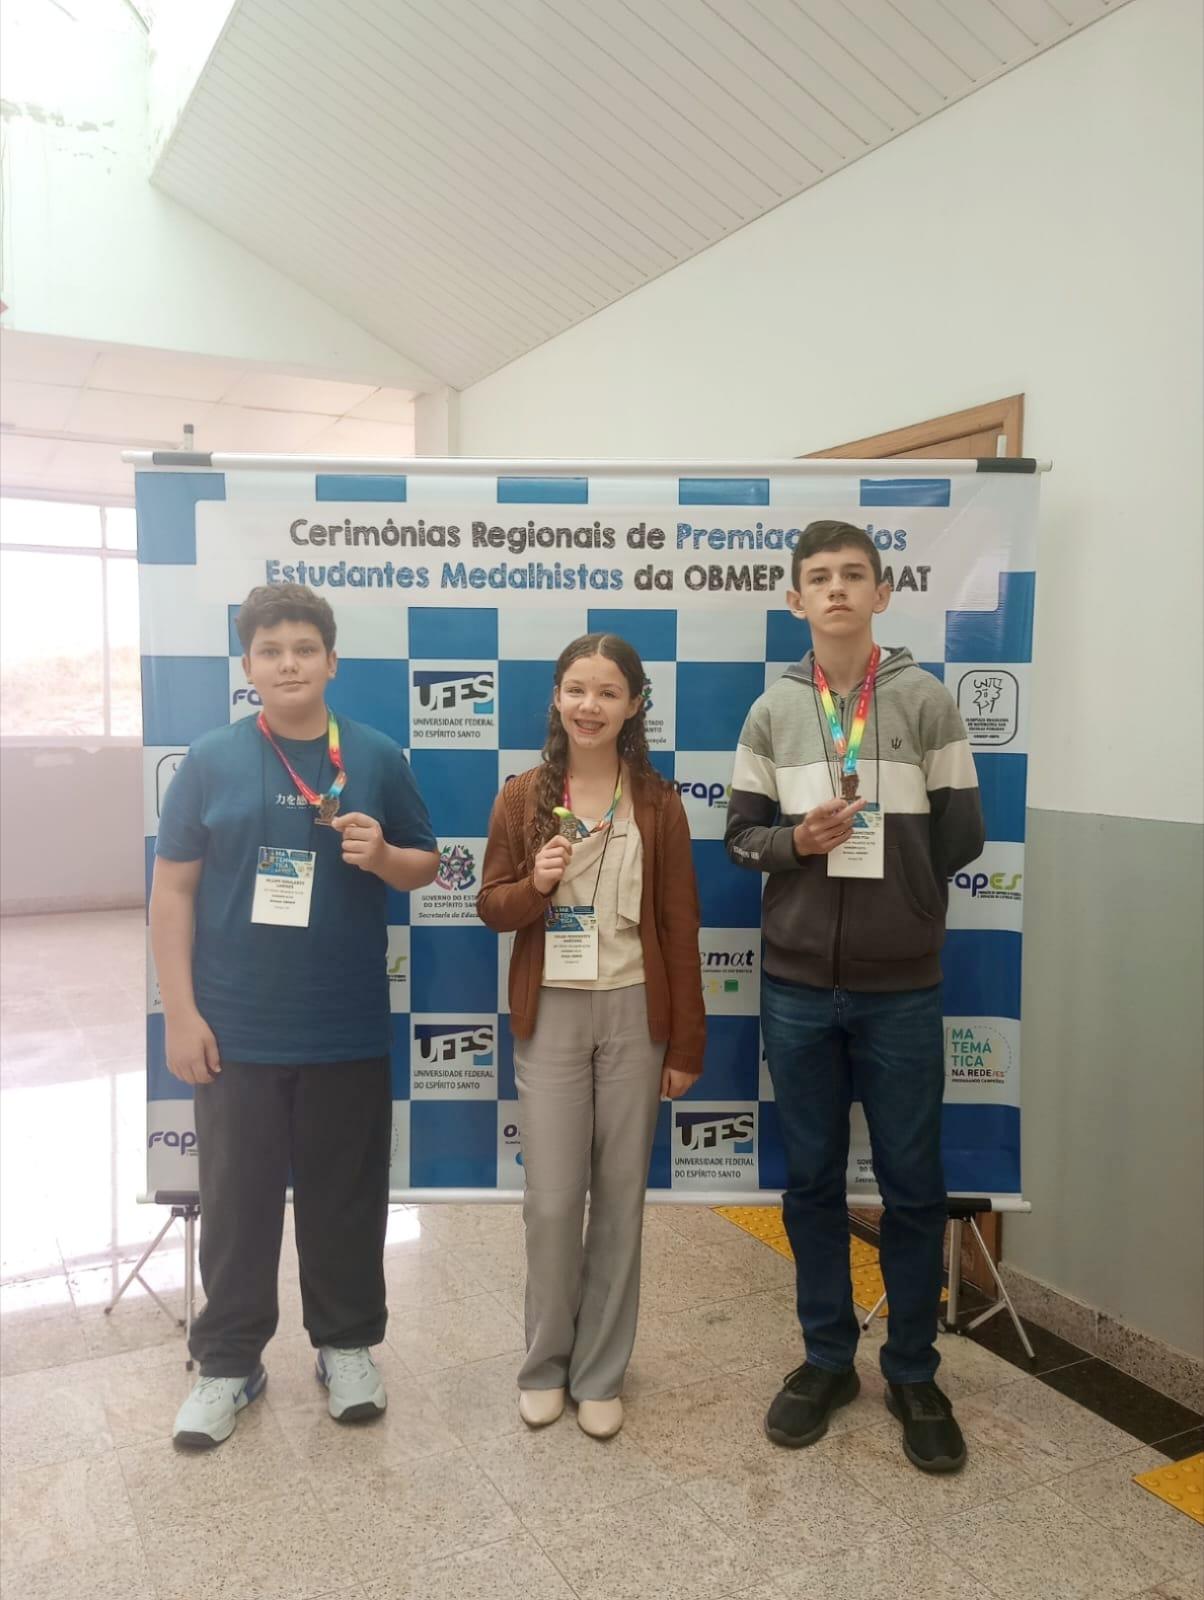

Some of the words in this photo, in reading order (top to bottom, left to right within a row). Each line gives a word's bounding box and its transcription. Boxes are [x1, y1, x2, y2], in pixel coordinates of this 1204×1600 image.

[290, 518, 461, 547] Cerimônias
[471, 520, 615, 554] Regionais
[626, 522, 666, 550] de
[266, 559, 430, 588] Estudantes
[441, 561, 623, 591] Medalhistas
[634, 564, 674, 591] da
[684, 564, 785, 592] OBMEP
[413, 671, 494, 712] UFES
[413, 718, 464, 726] UNIVERSIDADE
[465, 718, 495, 727] FEDERAL
[413, 730, 424, 738] DO
[425, 729, 456, 738] ESPÍRITO
[457, 730, 481, 738] SANTO
[952, 1029, 974, 1040] MA
[414, 1025, 493, 1063] UFES
[952, 1038, 992, 1053] TEMÁ
[952, 1055, 984, 1066] TICA
[414, 1070, 464, 1078] UNIVERSIDADE
[465, 1070, 495, 1078] FEDERAL
[952, 1069, 965, 1077] NA
[426, 1080, 455, 1089] ESPÍRITO
[676, 1112, 753, 1151] UFES
[675, 1158, 723, 1166] UNIVERSIDADE
[725, 1158, 754, 1167] FEDERAL
[675, 1170, 685, 1178] DO
[718, 1170, 741, 1178] SANTO
